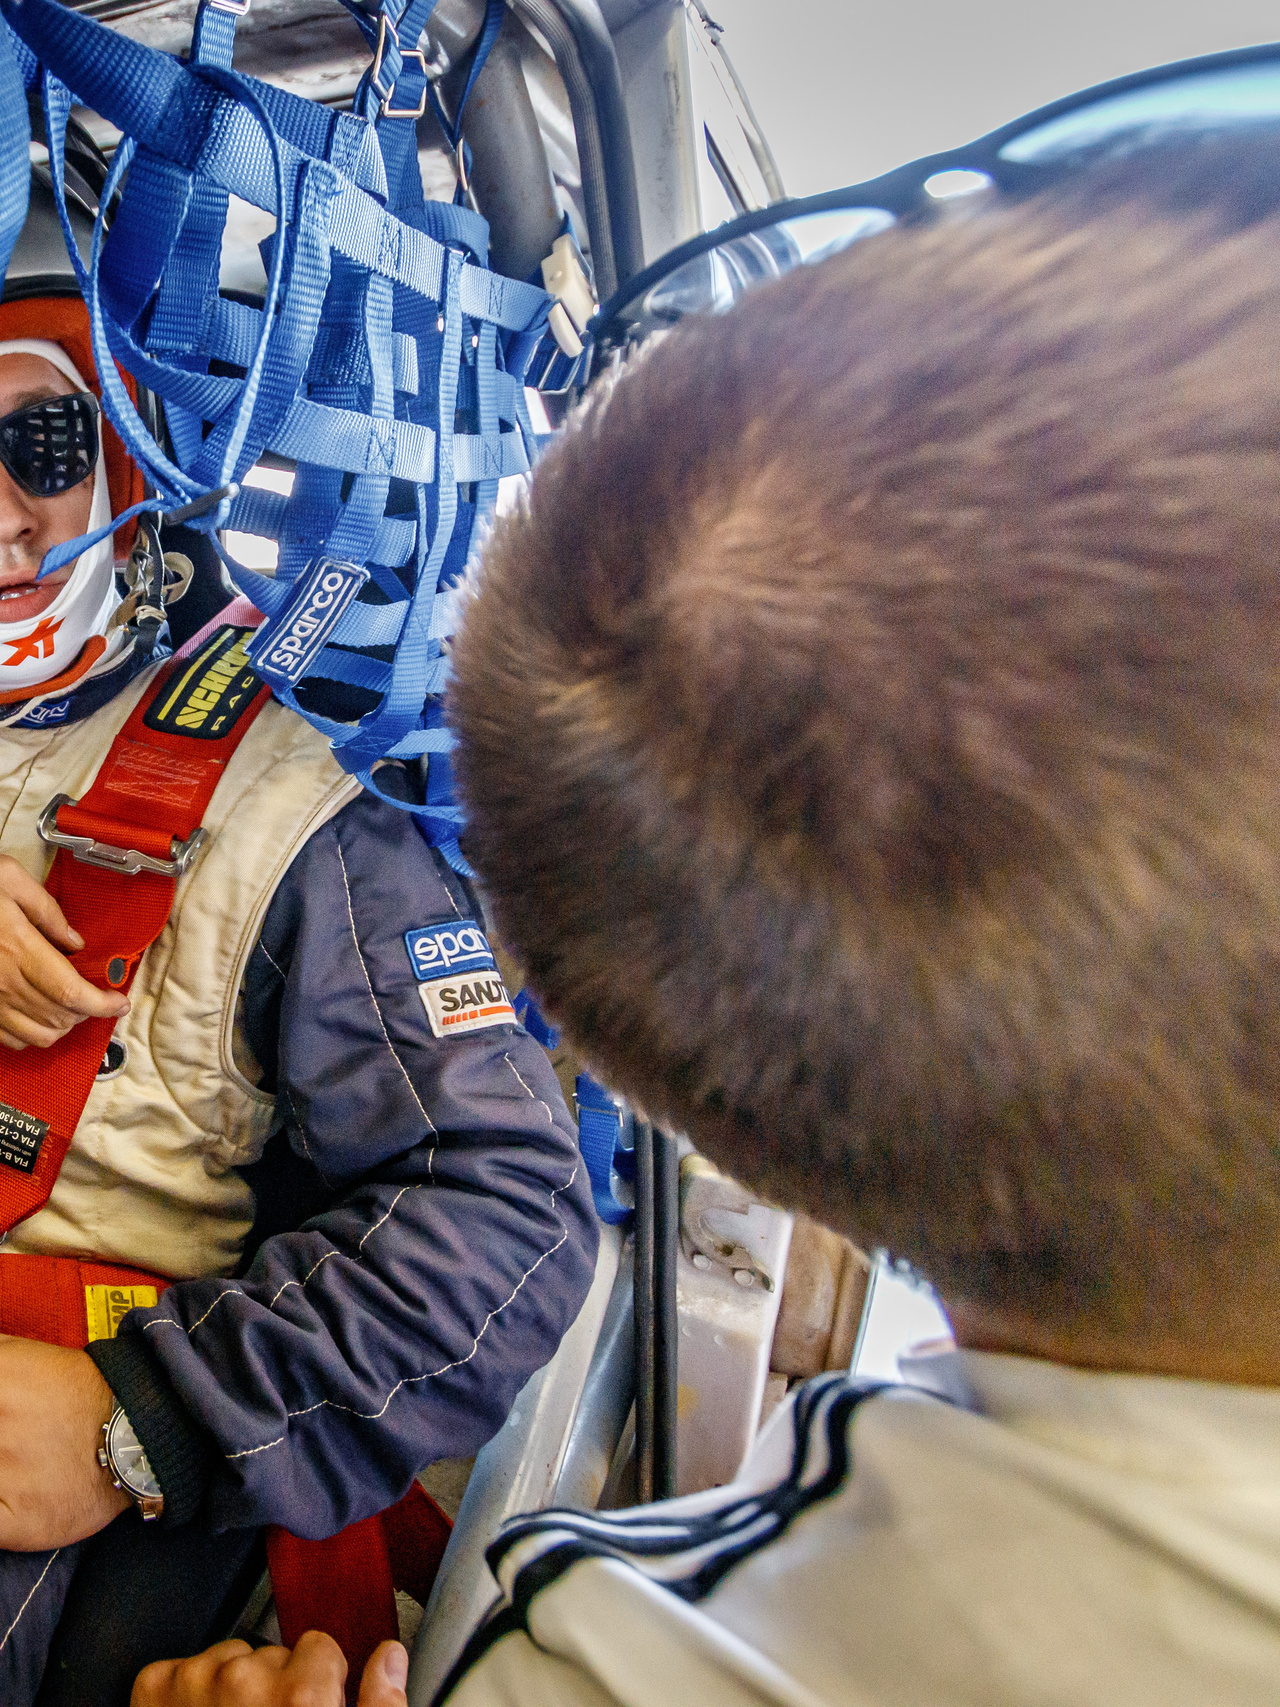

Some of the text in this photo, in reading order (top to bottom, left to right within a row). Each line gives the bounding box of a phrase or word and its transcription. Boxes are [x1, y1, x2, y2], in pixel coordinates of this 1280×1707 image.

[271, 572, 344, 667] sparco
[210, 675, 254, 731] RAC
[414, 928, 487, 968] spar
[439, 980, 508, 1012] SANDT
[21, 1134, 36, 1148] FIA
[25, 1122, 40, 1136] FIA
[14, 1156, 29, 1168] FIA
[109, 1290, 130, 1331] MP
